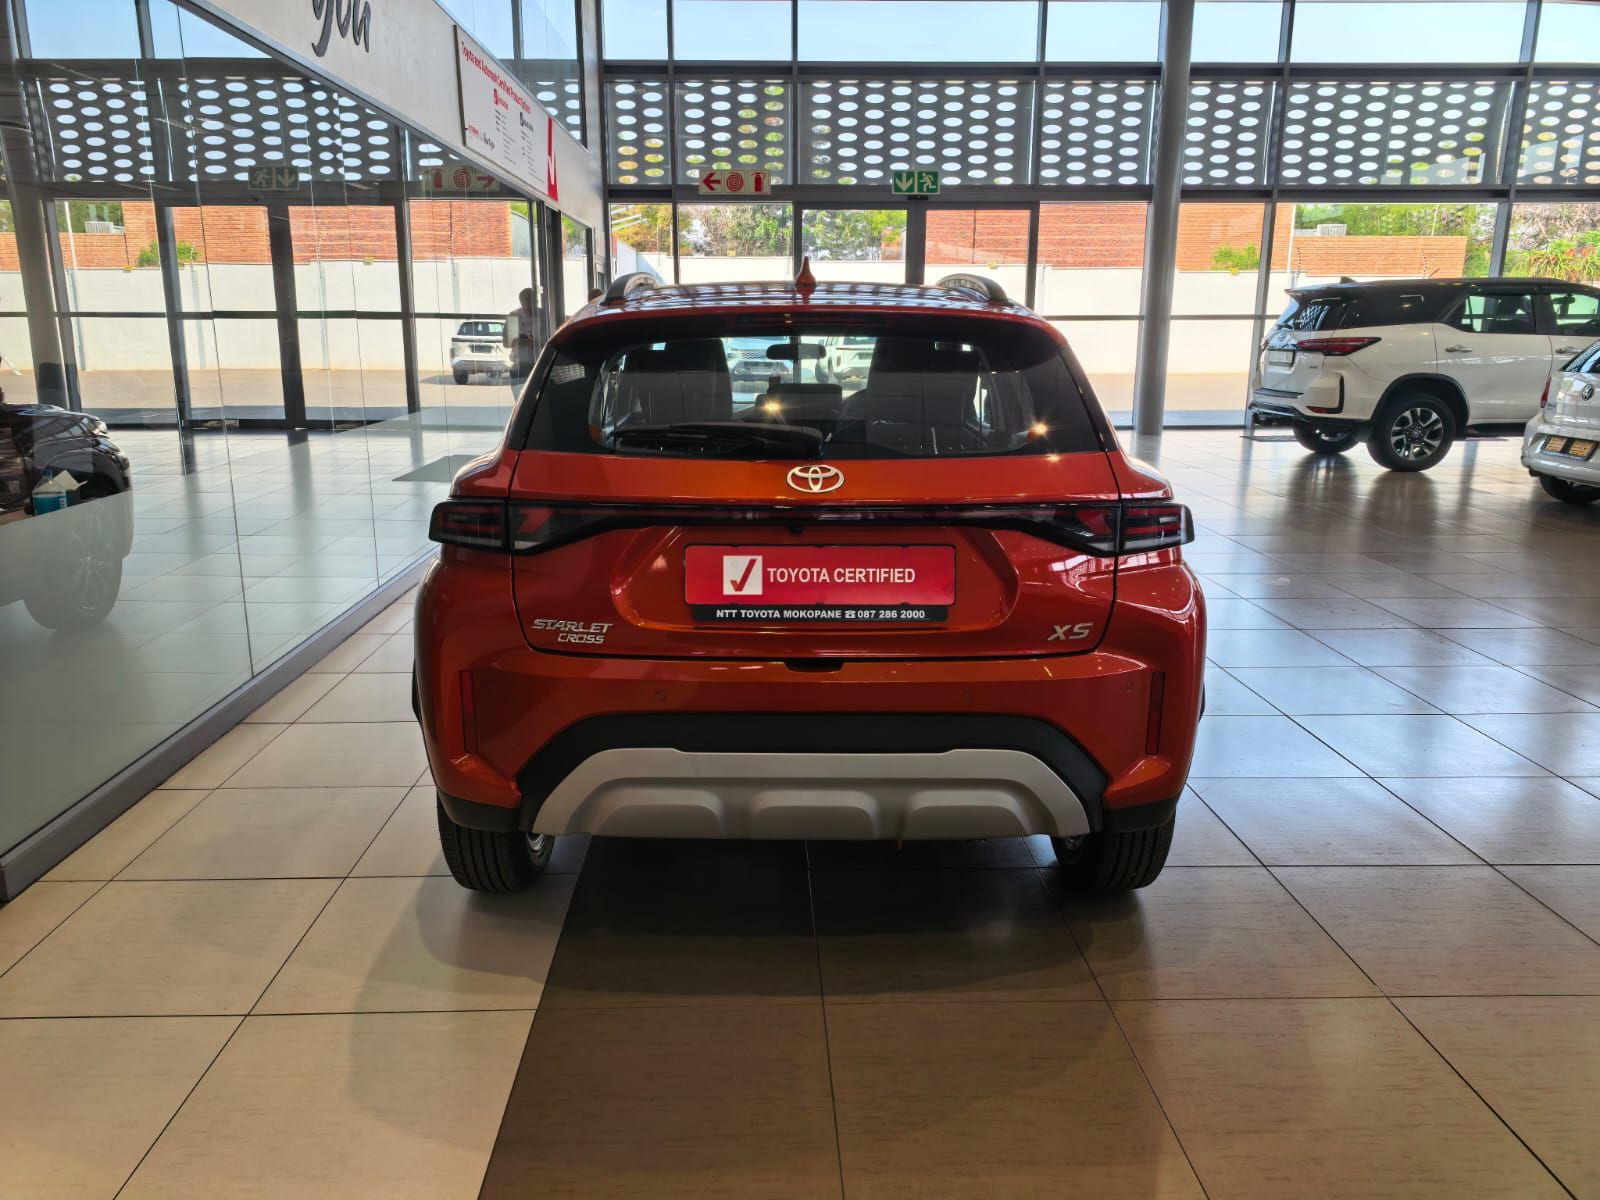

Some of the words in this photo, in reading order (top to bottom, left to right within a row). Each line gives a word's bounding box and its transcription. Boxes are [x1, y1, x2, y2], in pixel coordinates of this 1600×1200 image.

[767, 567, 830, 583] TOYOTA
[833, 567, 916, 583] CERTIFIED
[716, 609, 738, 618] NTT
[740, 609, 781, 618] TOYOTA
[783, 609, 842, 619] MOKOPANE
[857, 609, 876, 619] 087
[878, 609, 898, 619] 286
[900, 609, 926, 619] 2000
[531, 618, 613, 633] STARLET
[1047, 622, 1093, 641] XS
[557, 632, 605, 644] CROSS
